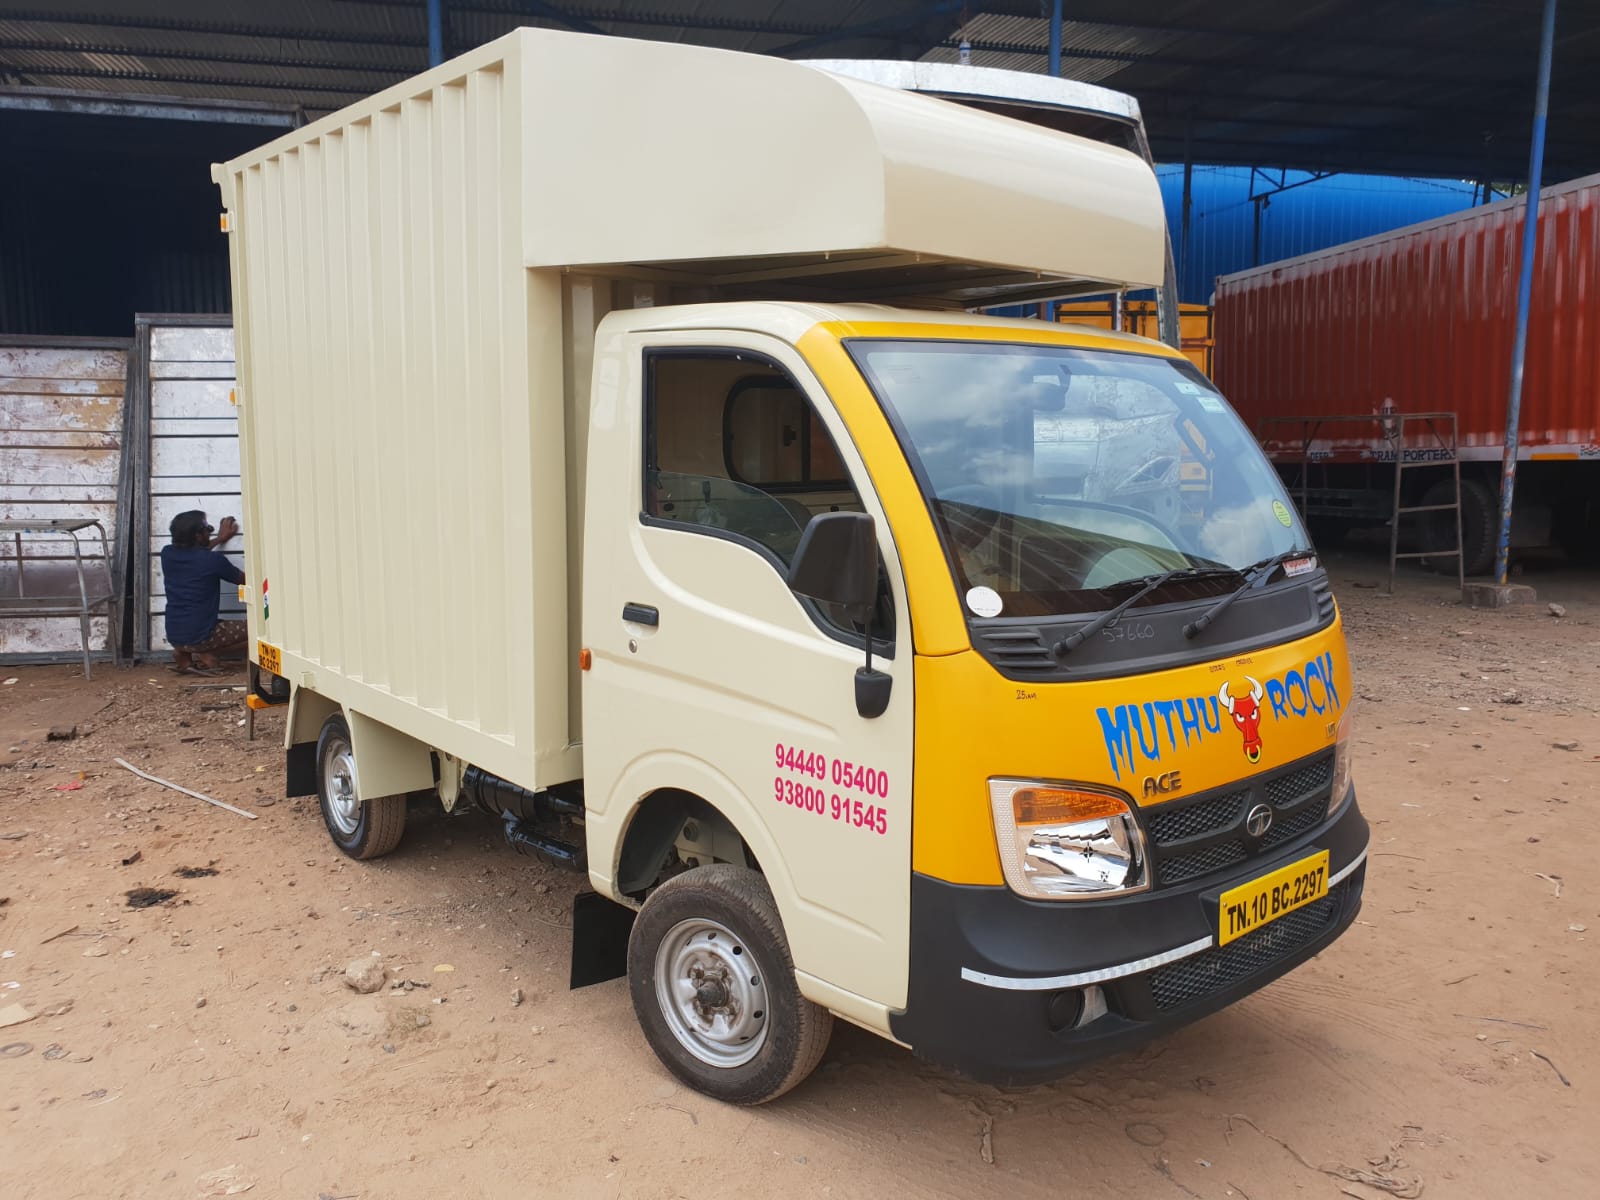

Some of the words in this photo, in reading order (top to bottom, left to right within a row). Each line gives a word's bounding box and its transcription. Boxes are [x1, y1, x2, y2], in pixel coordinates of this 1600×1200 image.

[1096, 695, 1221, 782] MUTHU
[1265, 652, 1339, 721] ROCK
[775, 743, 827, 780] 94449
[831, 758, 888, 799] 05400
[1142, 769, 1182, 799] ACE
[775, 776, 826, 816] 93800
[830, 793, 888, 836] 91545
[1227, 891, 1268, 936] TN.10
[1271, 866, 1324, 916] BC.2297
